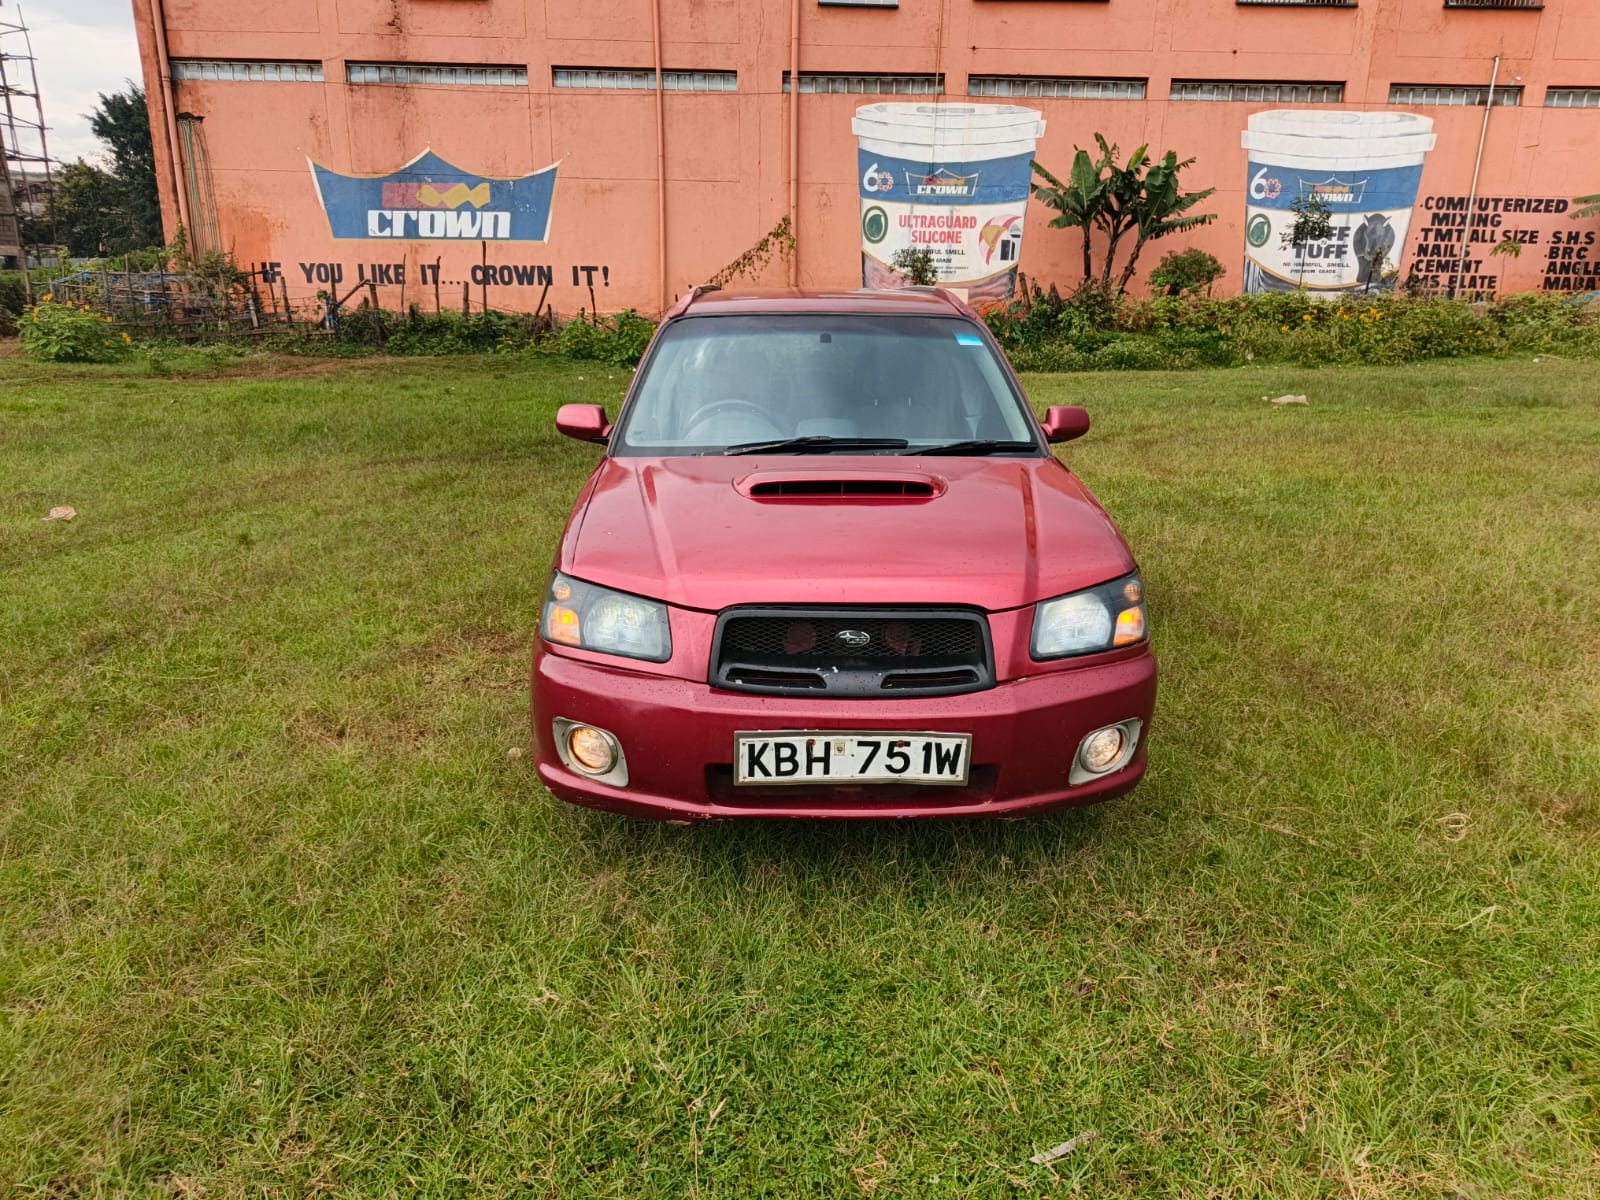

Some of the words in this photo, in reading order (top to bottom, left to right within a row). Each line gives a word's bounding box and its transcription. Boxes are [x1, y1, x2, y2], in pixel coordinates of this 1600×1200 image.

[916, 185, 968, 195] crown
[1424, 196, 1569, 214] COMPUTERIZED
[367, 209, 511, 238] crown
[898, 214, 977, 229] ULTRAGUARD
[1430, 213, 1503, 228] MIXING
[911, 231, 962, 244] SILICONE
[1421, 228, 1465, 242] TMT
[1469, 229, 1496, 243] ALL
[1502, 230, 1539, 244] SIZE
[1292, 244, 1348, 259] TUFF
[1414, 259, 1482, 274] CEMENT
[260, 262, 282, 283] IF
[298, 262, 343, 284] YOU
[358, 263, 405, 285] LIKE
[471, 265, 553, 287] CROWN
[572, 265, 611, 287] IT!
[1447, 275, 1497, 289] PLATE
[1542, 277, 1600, 290] MABA
[748, 741, 831, 777] KBH
